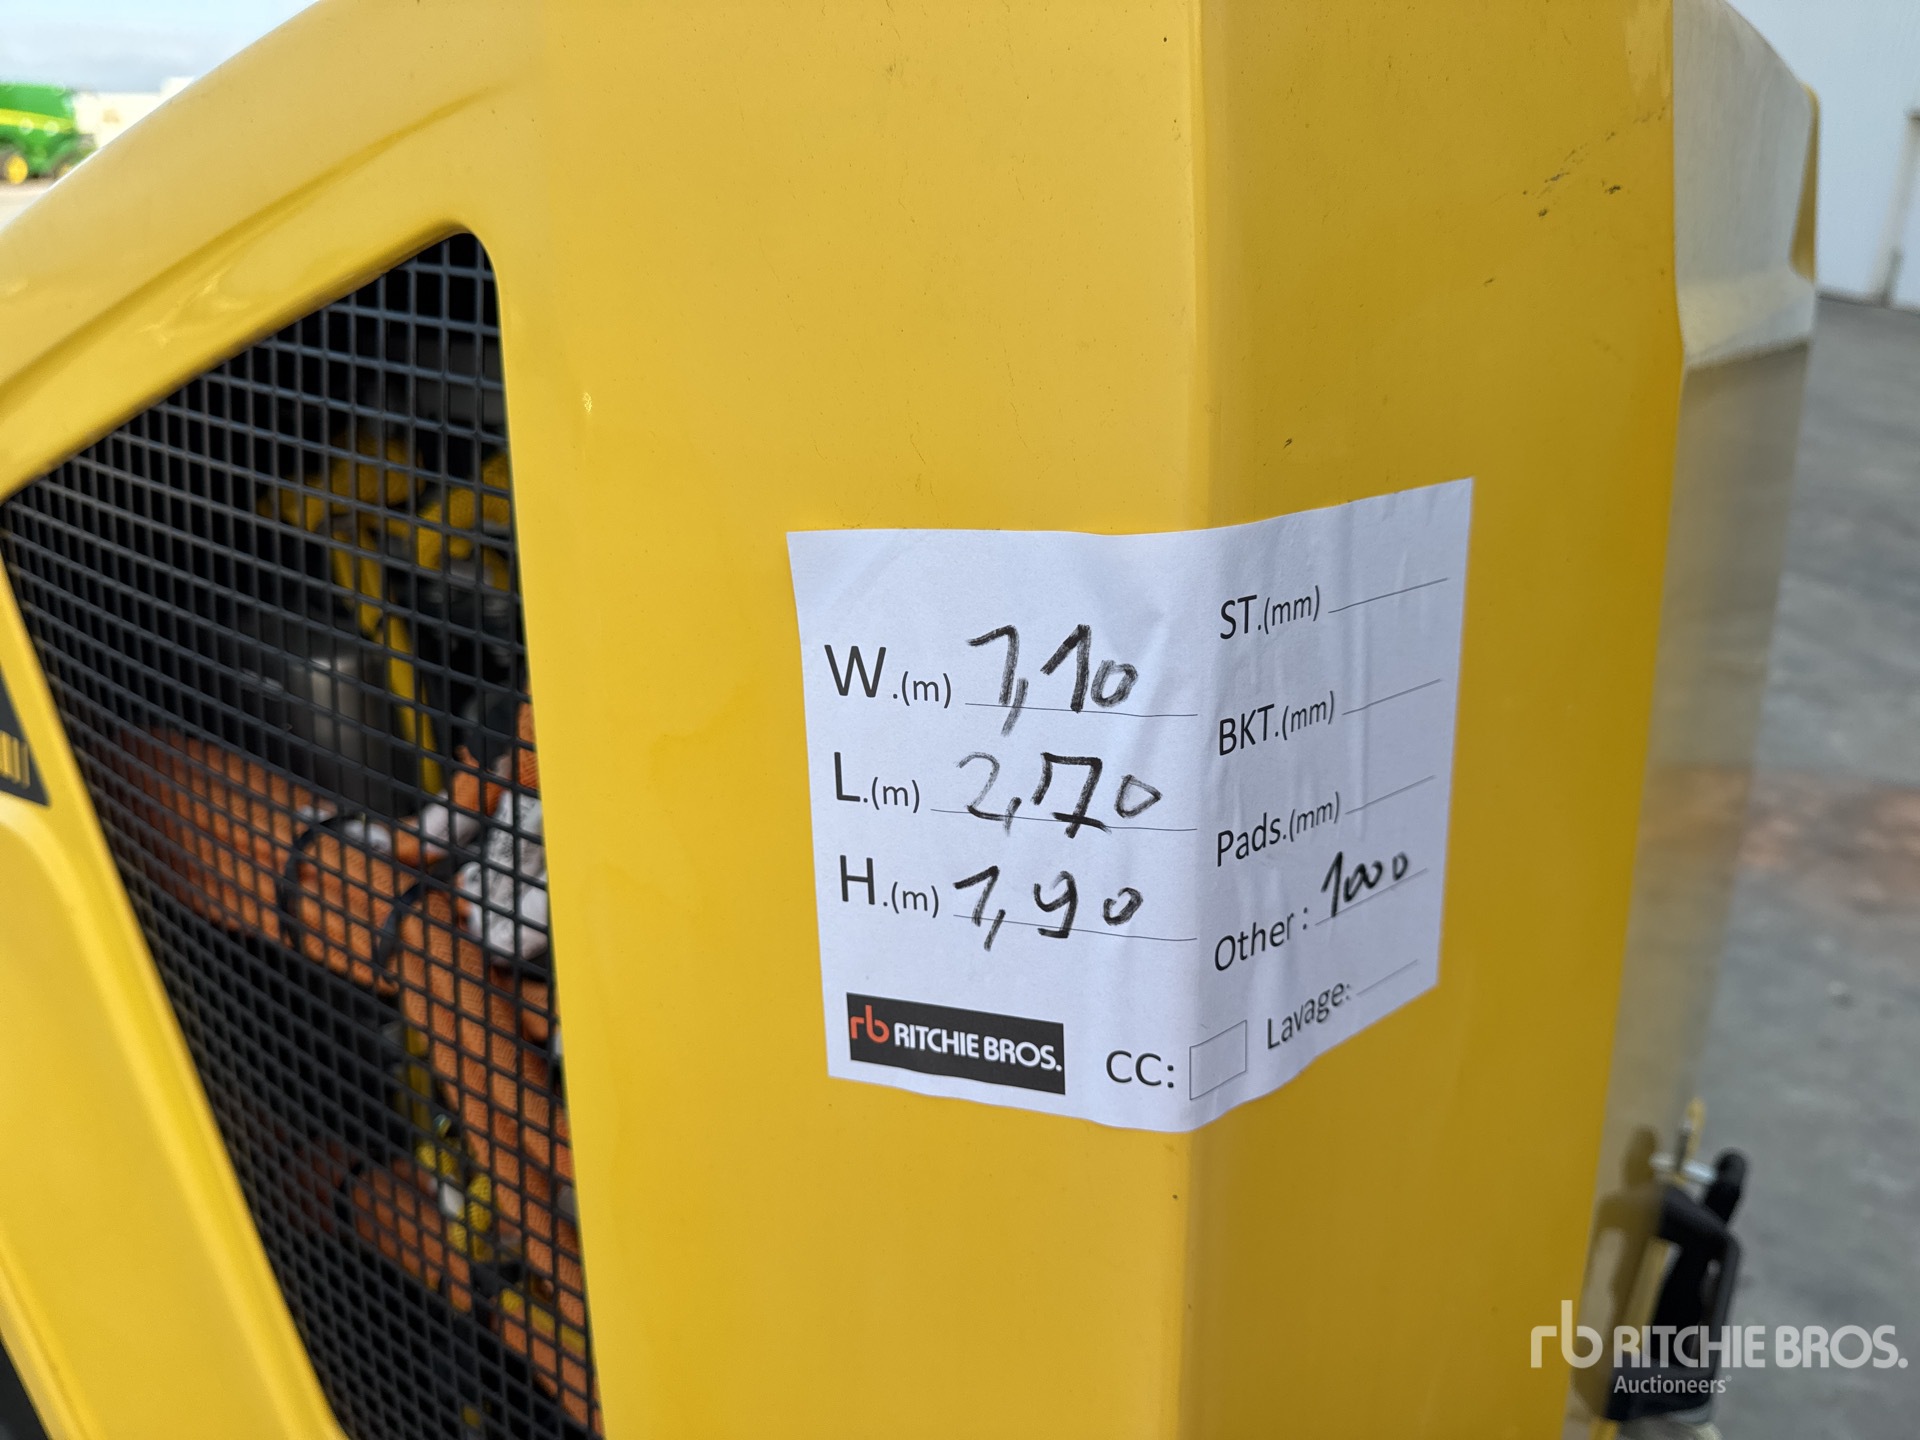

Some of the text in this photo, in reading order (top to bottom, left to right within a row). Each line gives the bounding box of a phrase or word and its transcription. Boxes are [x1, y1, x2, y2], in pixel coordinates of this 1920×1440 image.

[1220, 585, 1320, 640] ST.(mm)
[824, 644, 952, 709] W.(m)
[966, 624, 1139, 736] 1,10
[1219, 690, 1335, 756] BKT.(mm)
[834, 751, 920, 813] L.(m)
[1217, 791, 1340, 867] Pads.(mm)
[840, 854, 939, 918] H.(m)
[953, 865, 1143, 951] 1,90
[850, 1004, 1063, 1072] rb RITCHIE BROS.
[1267, 982, 1351, 1050] Lavage:
[1105, 1049, 1175, 1088] CC:
